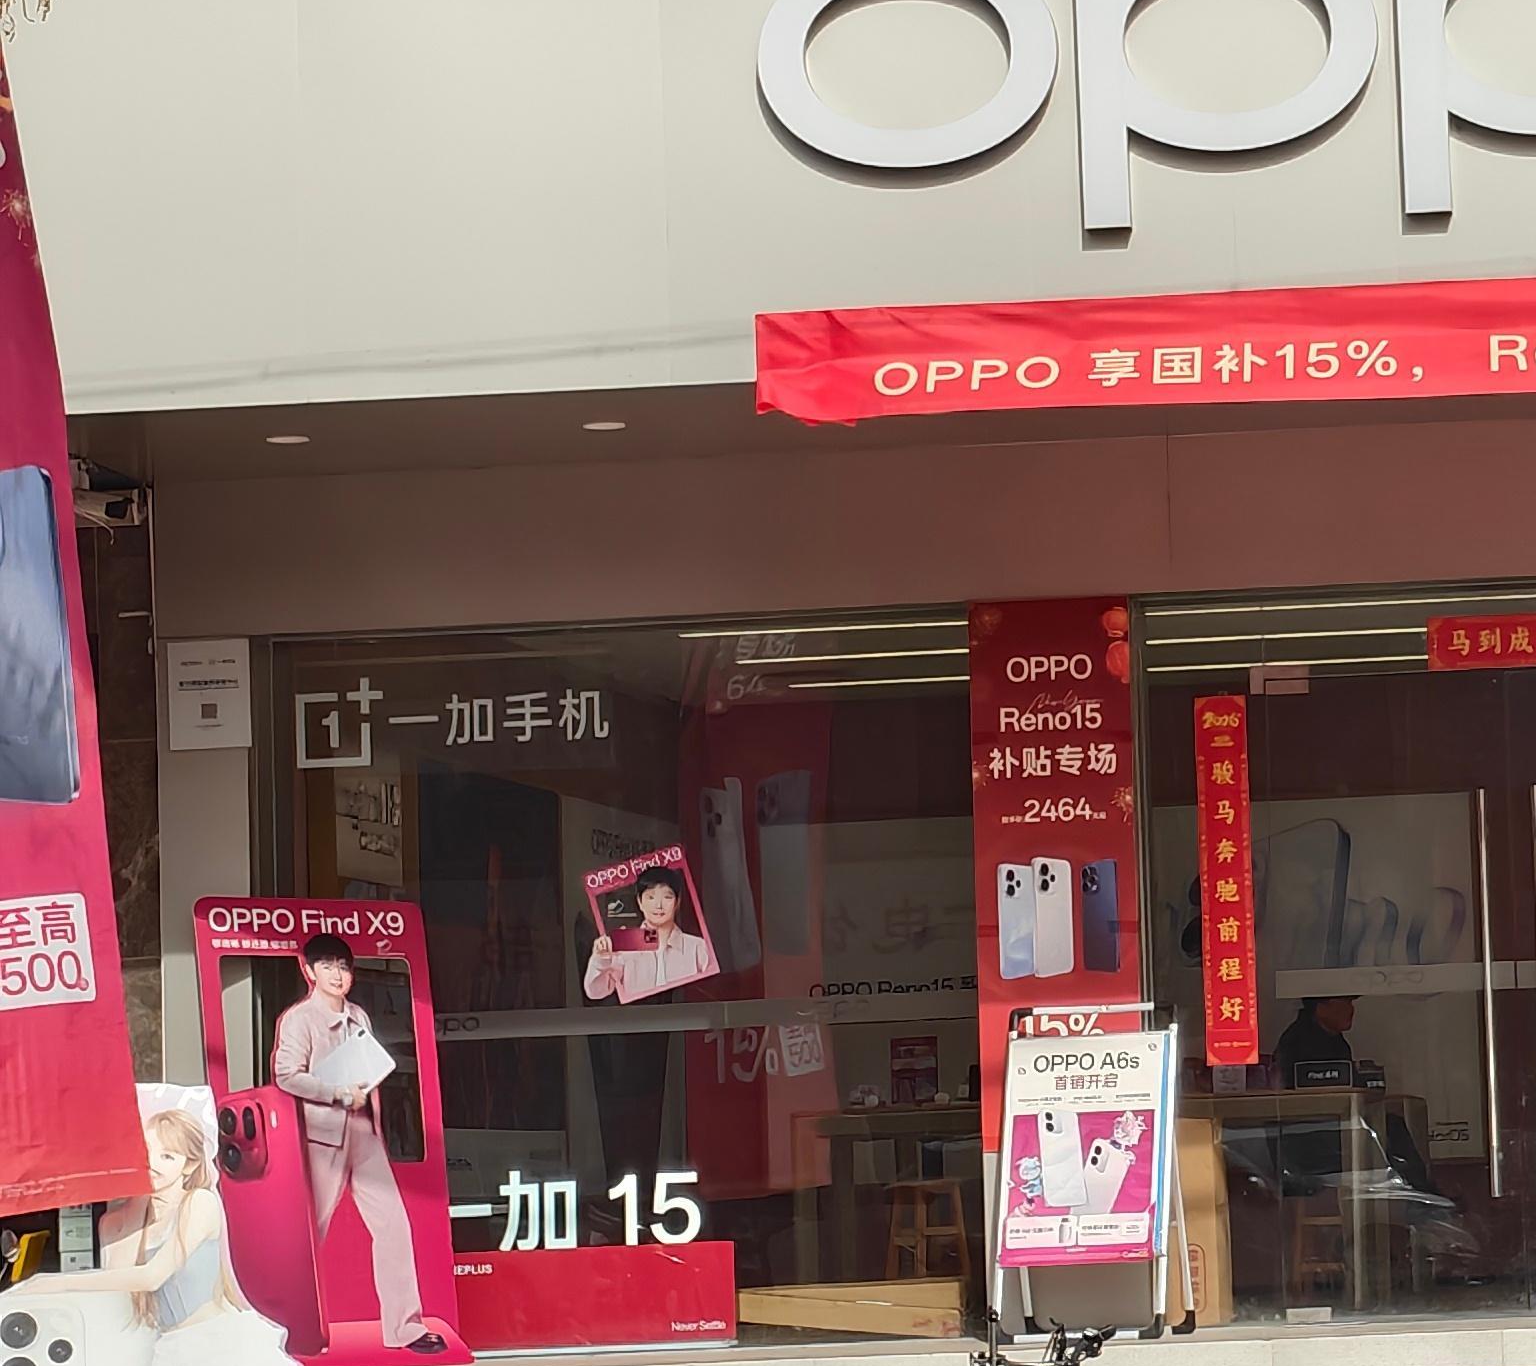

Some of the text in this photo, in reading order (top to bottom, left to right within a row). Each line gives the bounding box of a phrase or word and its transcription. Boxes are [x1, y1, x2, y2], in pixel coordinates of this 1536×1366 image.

[873, 355, 1062, 397] OPPO
[1006, 653, 1092, 683] OPPO
[388, 688, 610, 746] 一加手机
[999, 703, 1102, 733] Reno15
[988, 742, 1117, 780] 补贴专场
[1023, 796, 1094, 823] 2464
[587, 864, 629, 888] OPPO
[1211, 759, 1245, 1023] 骏马奔驰前程好
[0, 901, 77, 946] 至高
[208, 907, 405, 936] OPPO Find X9
[1033, 1051, 1140, 1074] OPPO A6s
[1054, 1073, 1120, 1091] 首销开启
[608, 1171, 701, 1246] 15
[454, 1264, 493, 1276] EPLUS
